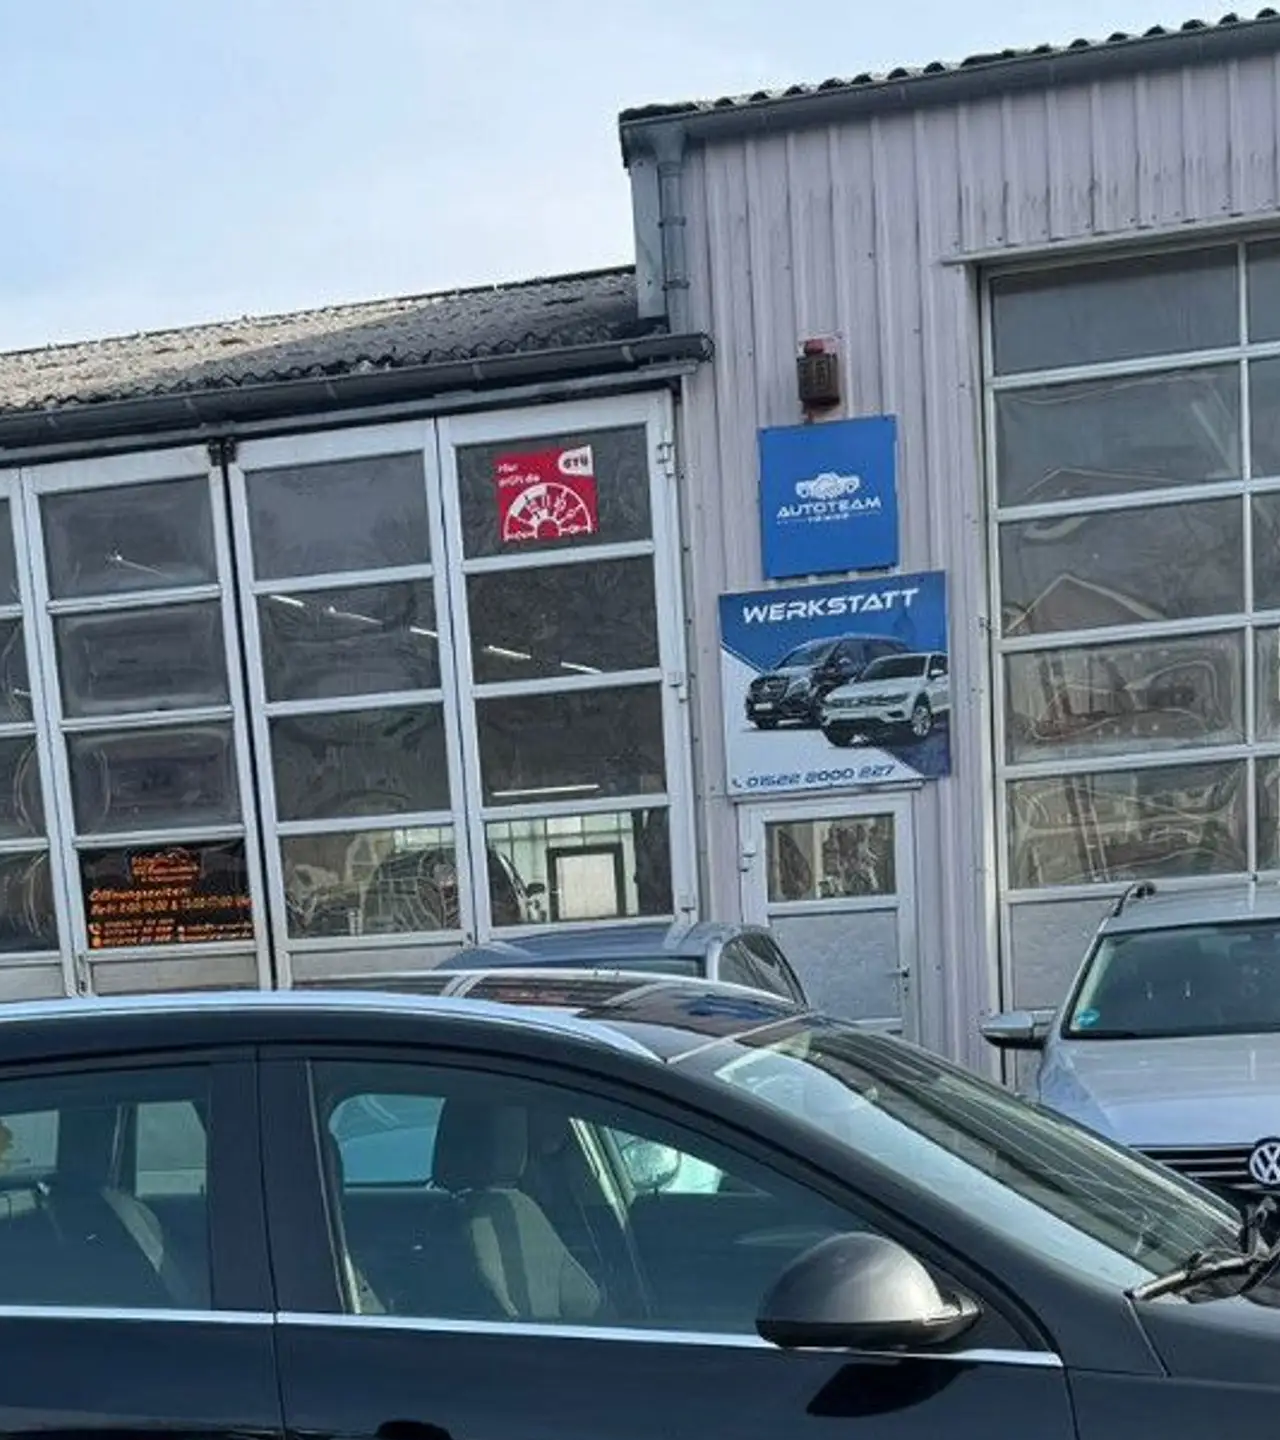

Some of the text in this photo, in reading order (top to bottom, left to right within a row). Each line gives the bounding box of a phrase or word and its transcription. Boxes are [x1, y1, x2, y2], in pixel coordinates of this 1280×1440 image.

[563, 454, 589, 469] GTÜ
[776, 496, 882, 519] AUTOTEAM
[743, 588, 920, 624] WERKSTATT
